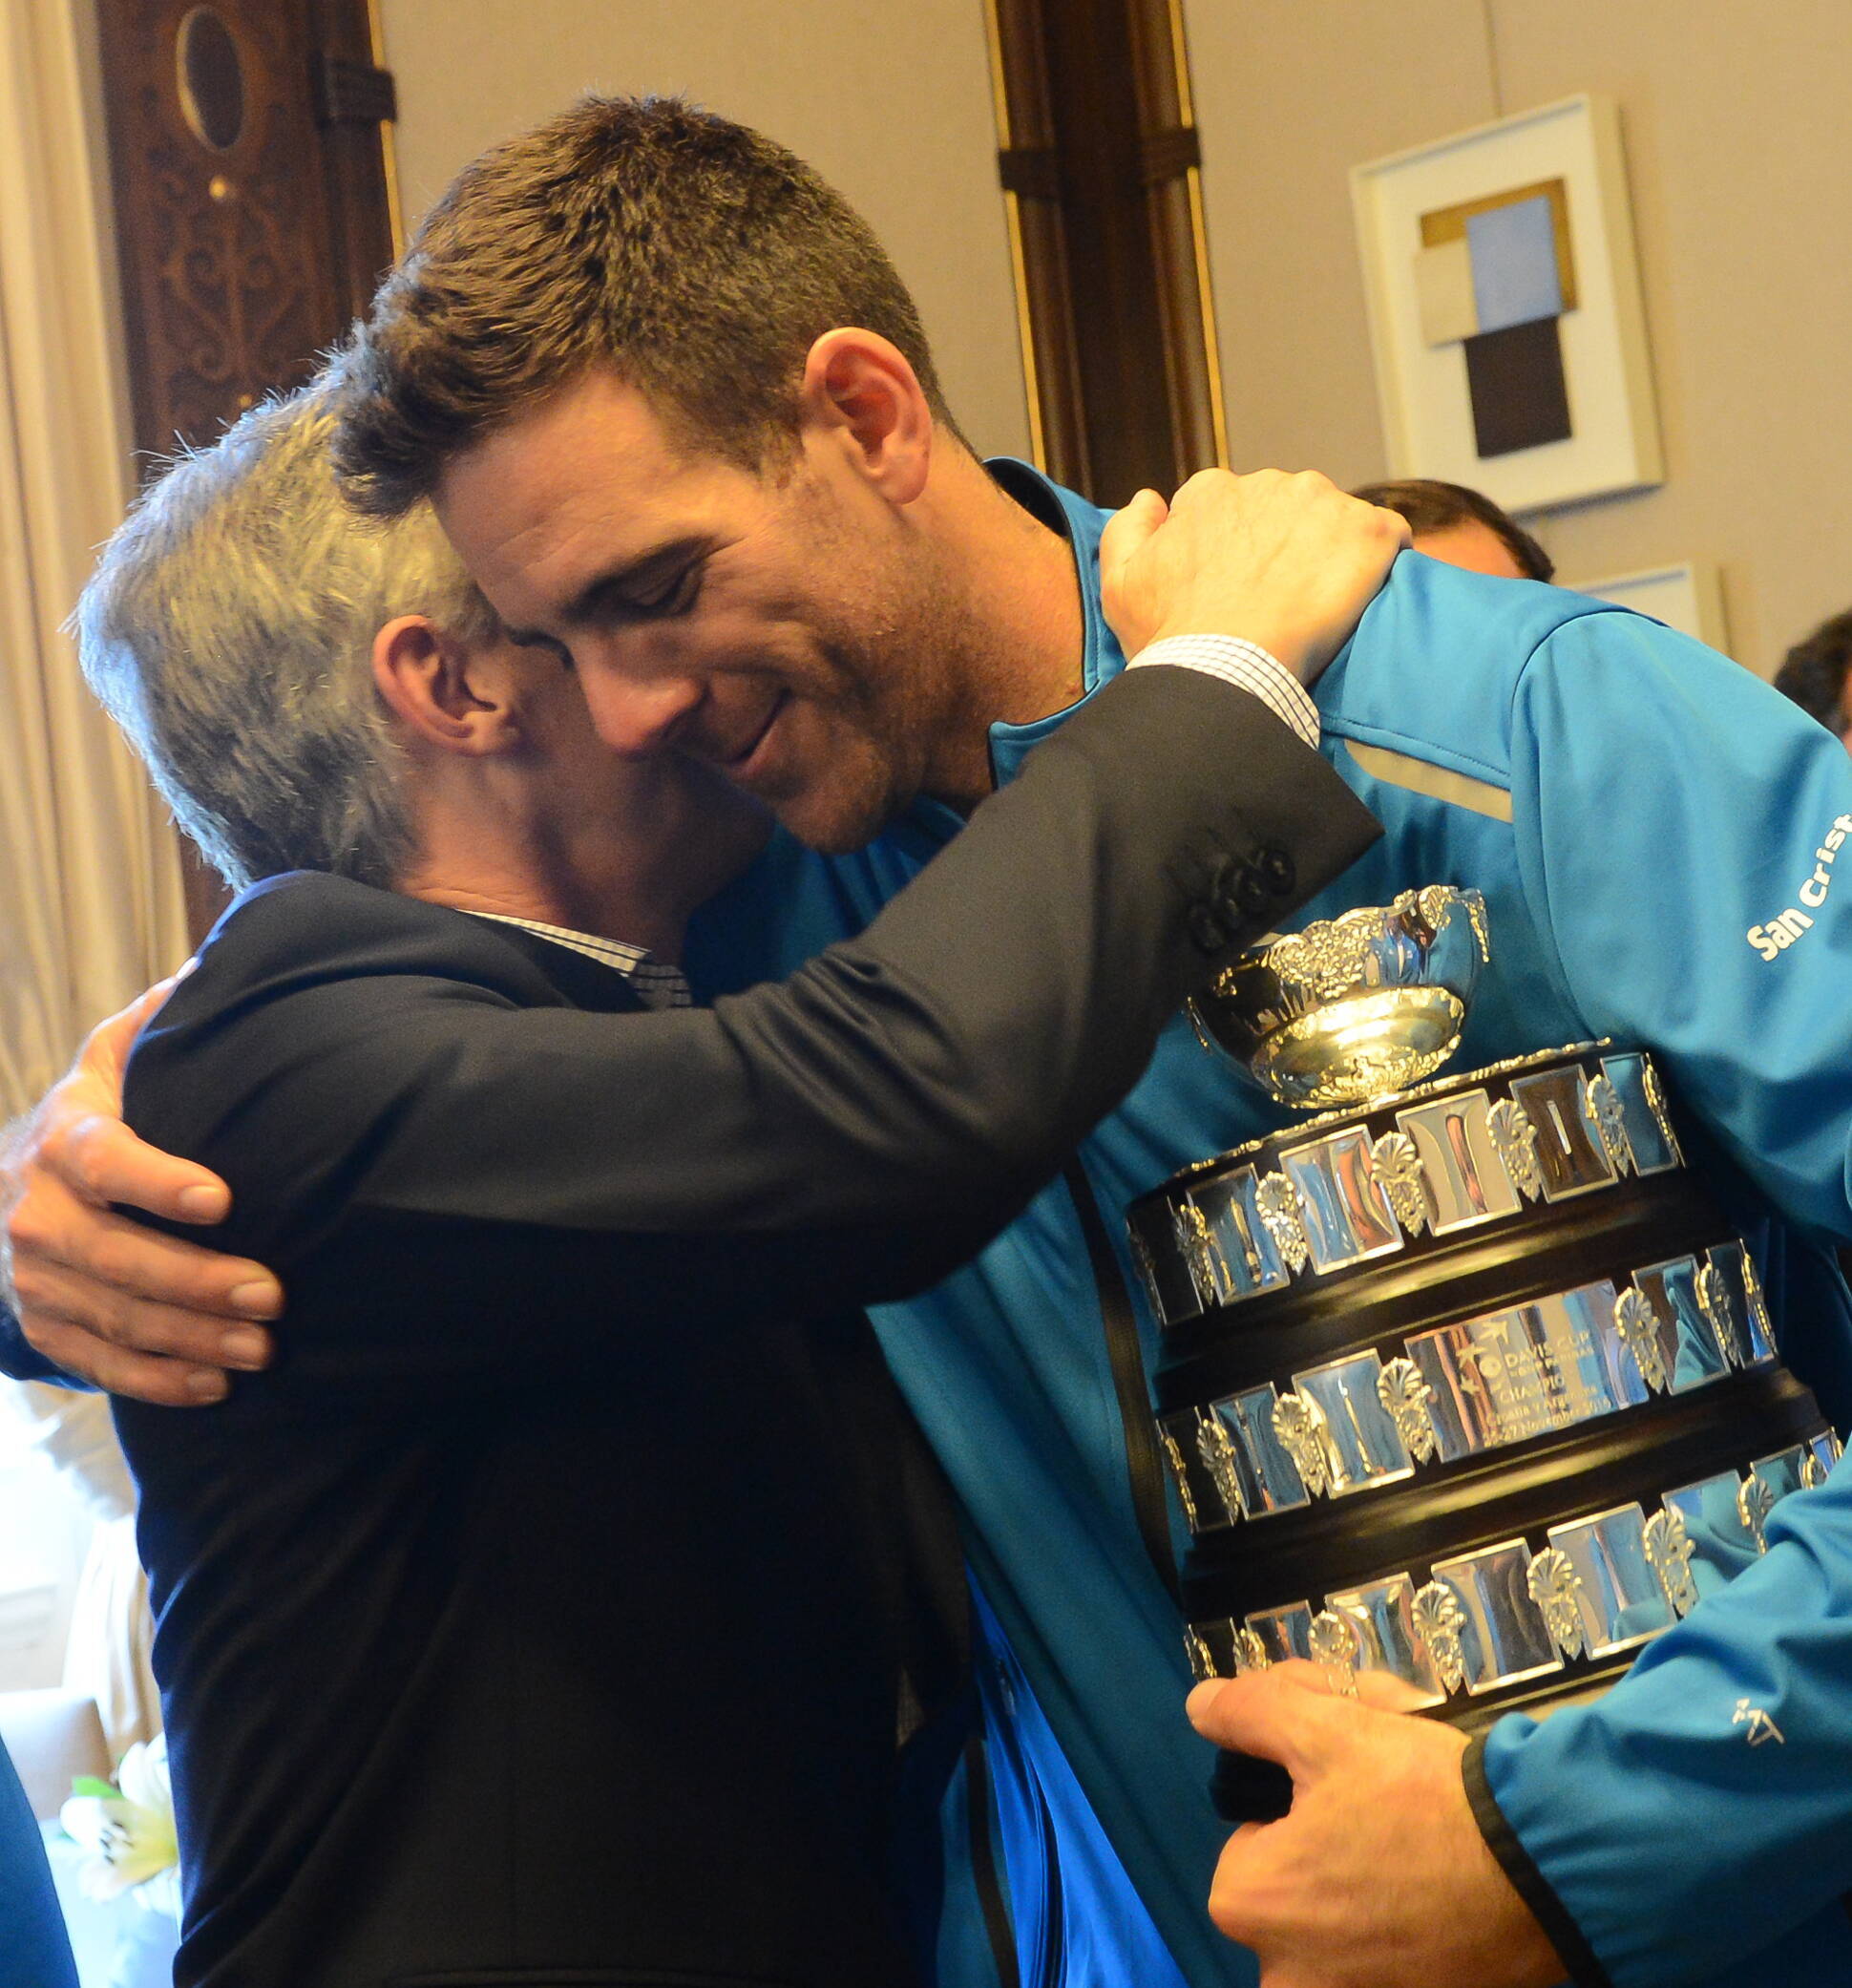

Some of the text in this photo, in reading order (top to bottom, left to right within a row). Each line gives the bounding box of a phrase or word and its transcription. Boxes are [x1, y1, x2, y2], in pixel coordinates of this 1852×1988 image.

[1746, 908, 1815, 962] San
[1505, 1329, 1590, 1368] DAVIS CUP
